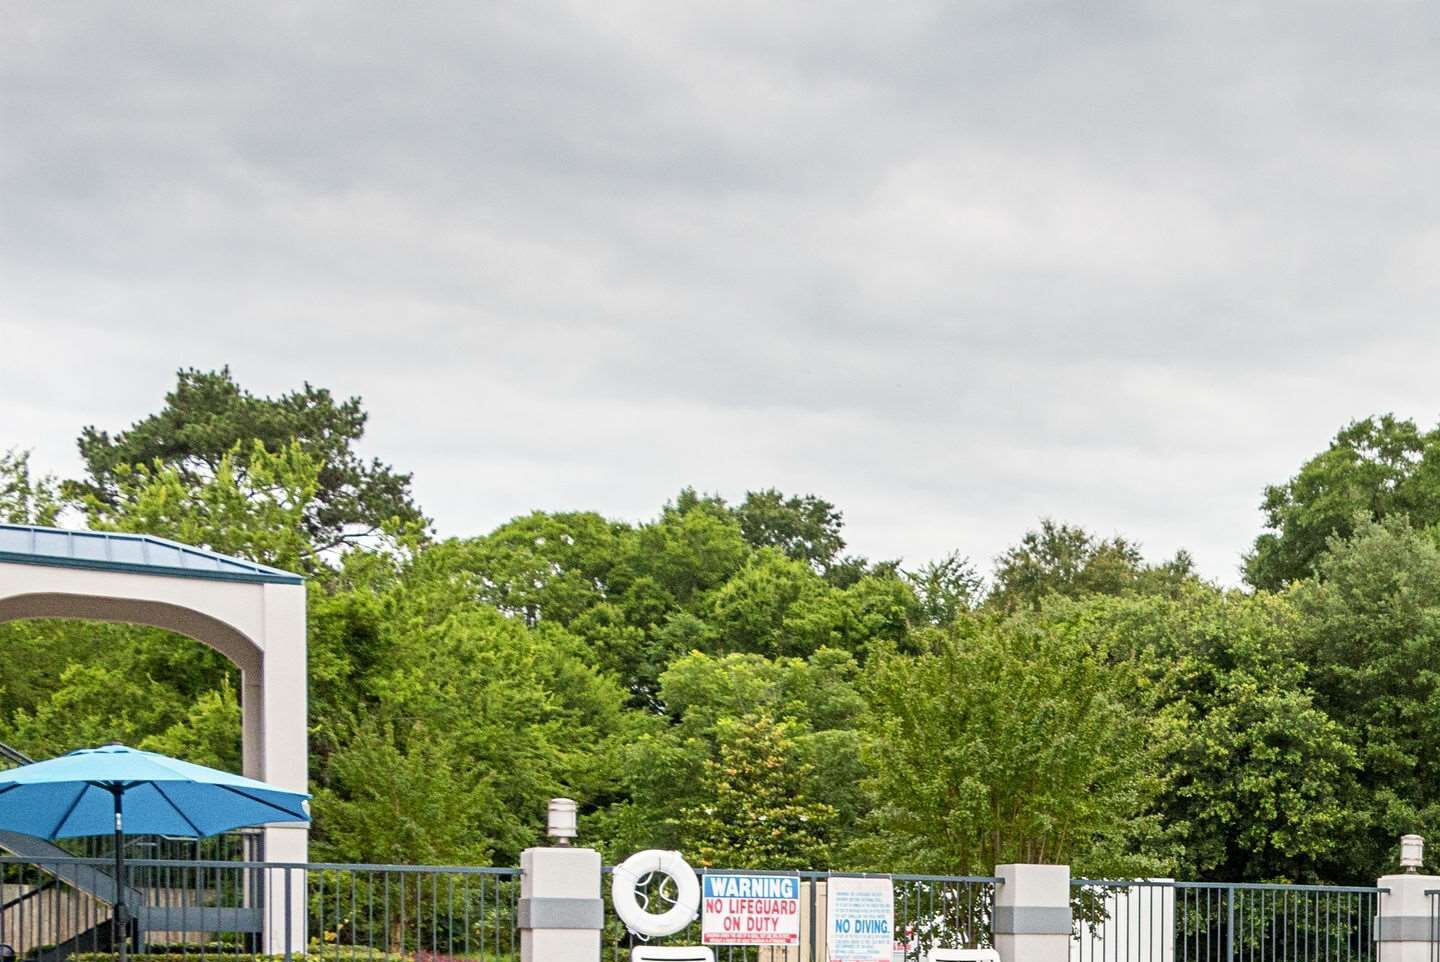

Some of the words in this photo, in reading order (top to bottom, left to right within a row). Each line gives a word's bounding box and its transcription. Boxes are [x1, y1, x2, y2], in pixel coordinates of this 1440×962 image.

[711, 877, 793, 898] WARNING
[706, 899, 723, 913] NO
[729, 900, 796, 915] LIFEGUARD
[723, 916, 740, 931] ON
[747, 917, 779, 932] DUTY
[835, 919, 850, 933] NO
